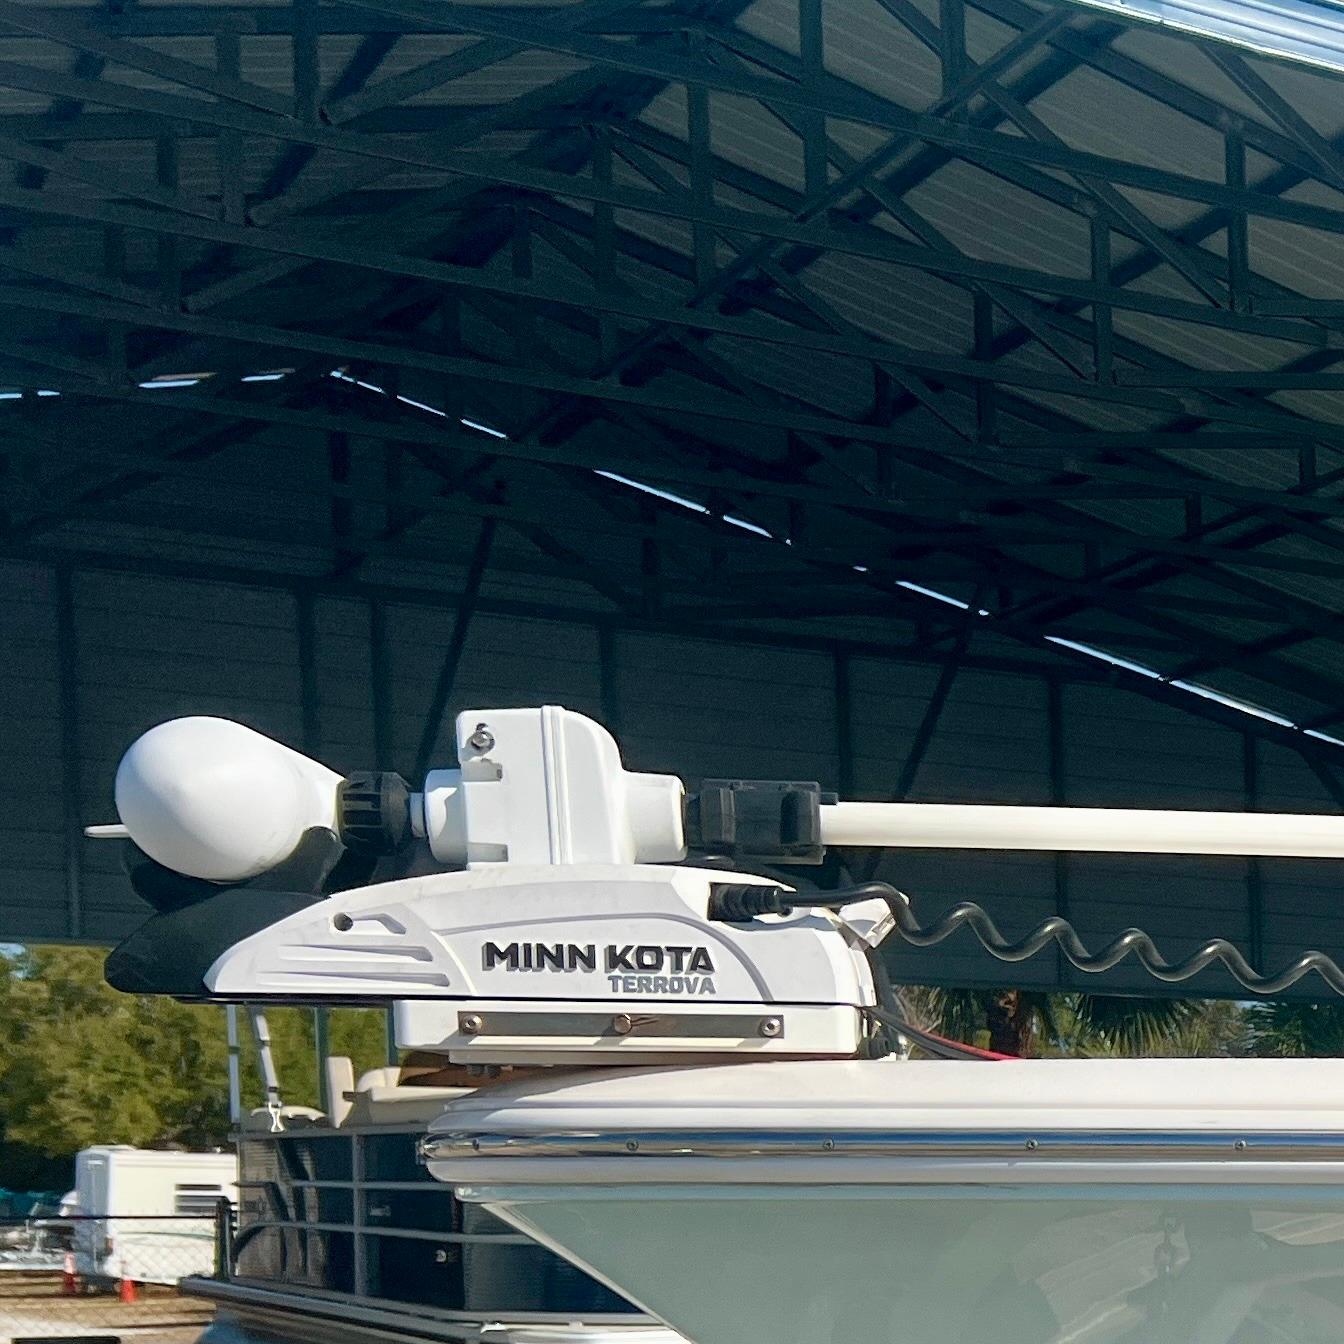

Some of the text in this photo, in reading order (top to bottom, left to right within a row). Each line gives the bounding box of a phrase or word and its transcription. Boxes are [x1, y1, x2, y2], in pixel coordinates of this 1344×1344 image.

[482, 942, 716, 975] MINN KOTA
[608, 975, 717, 995] TERROVA
